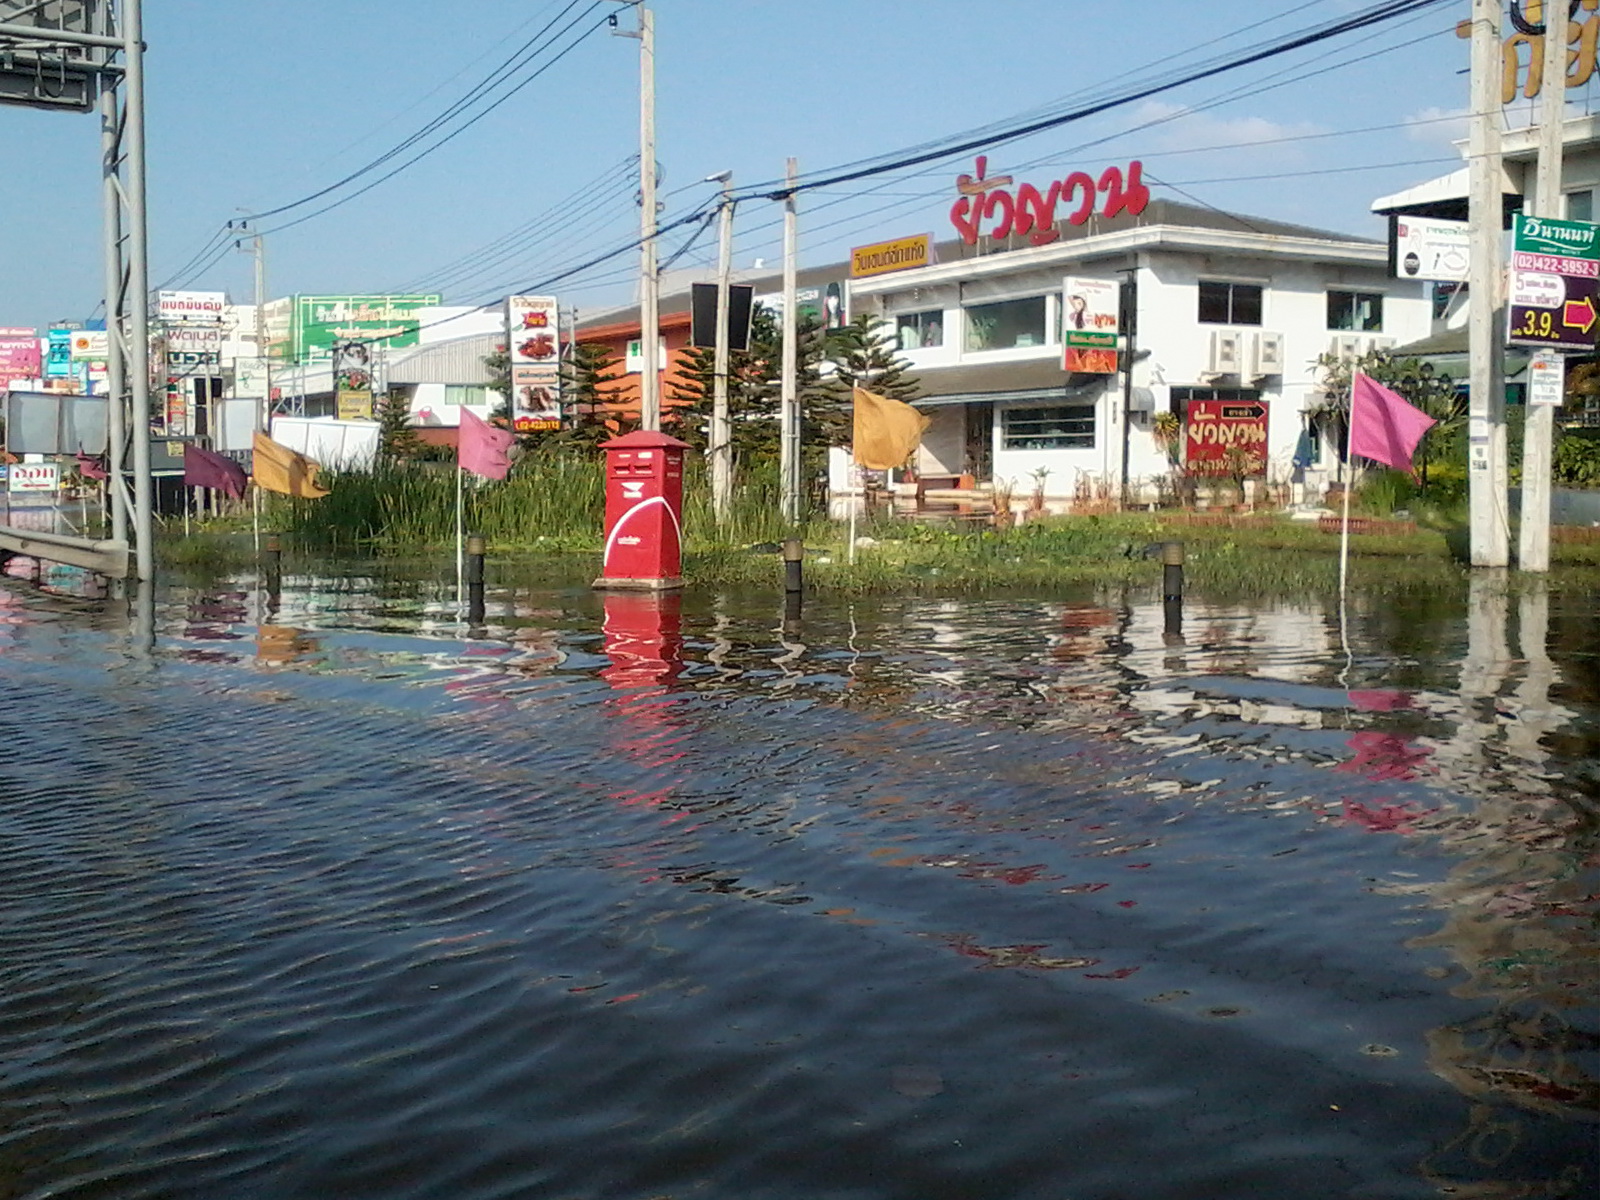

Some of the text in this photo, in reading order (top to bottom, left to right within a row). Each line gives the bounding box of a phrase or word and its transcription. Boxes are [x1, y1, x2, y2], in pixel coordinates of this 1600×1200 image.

[949, 155, 1150, 246] ยั่วญวน
[1514, 254, 1599, 277] (02)422-5952-3
[1523, 310, 1552, 337] 3.9
